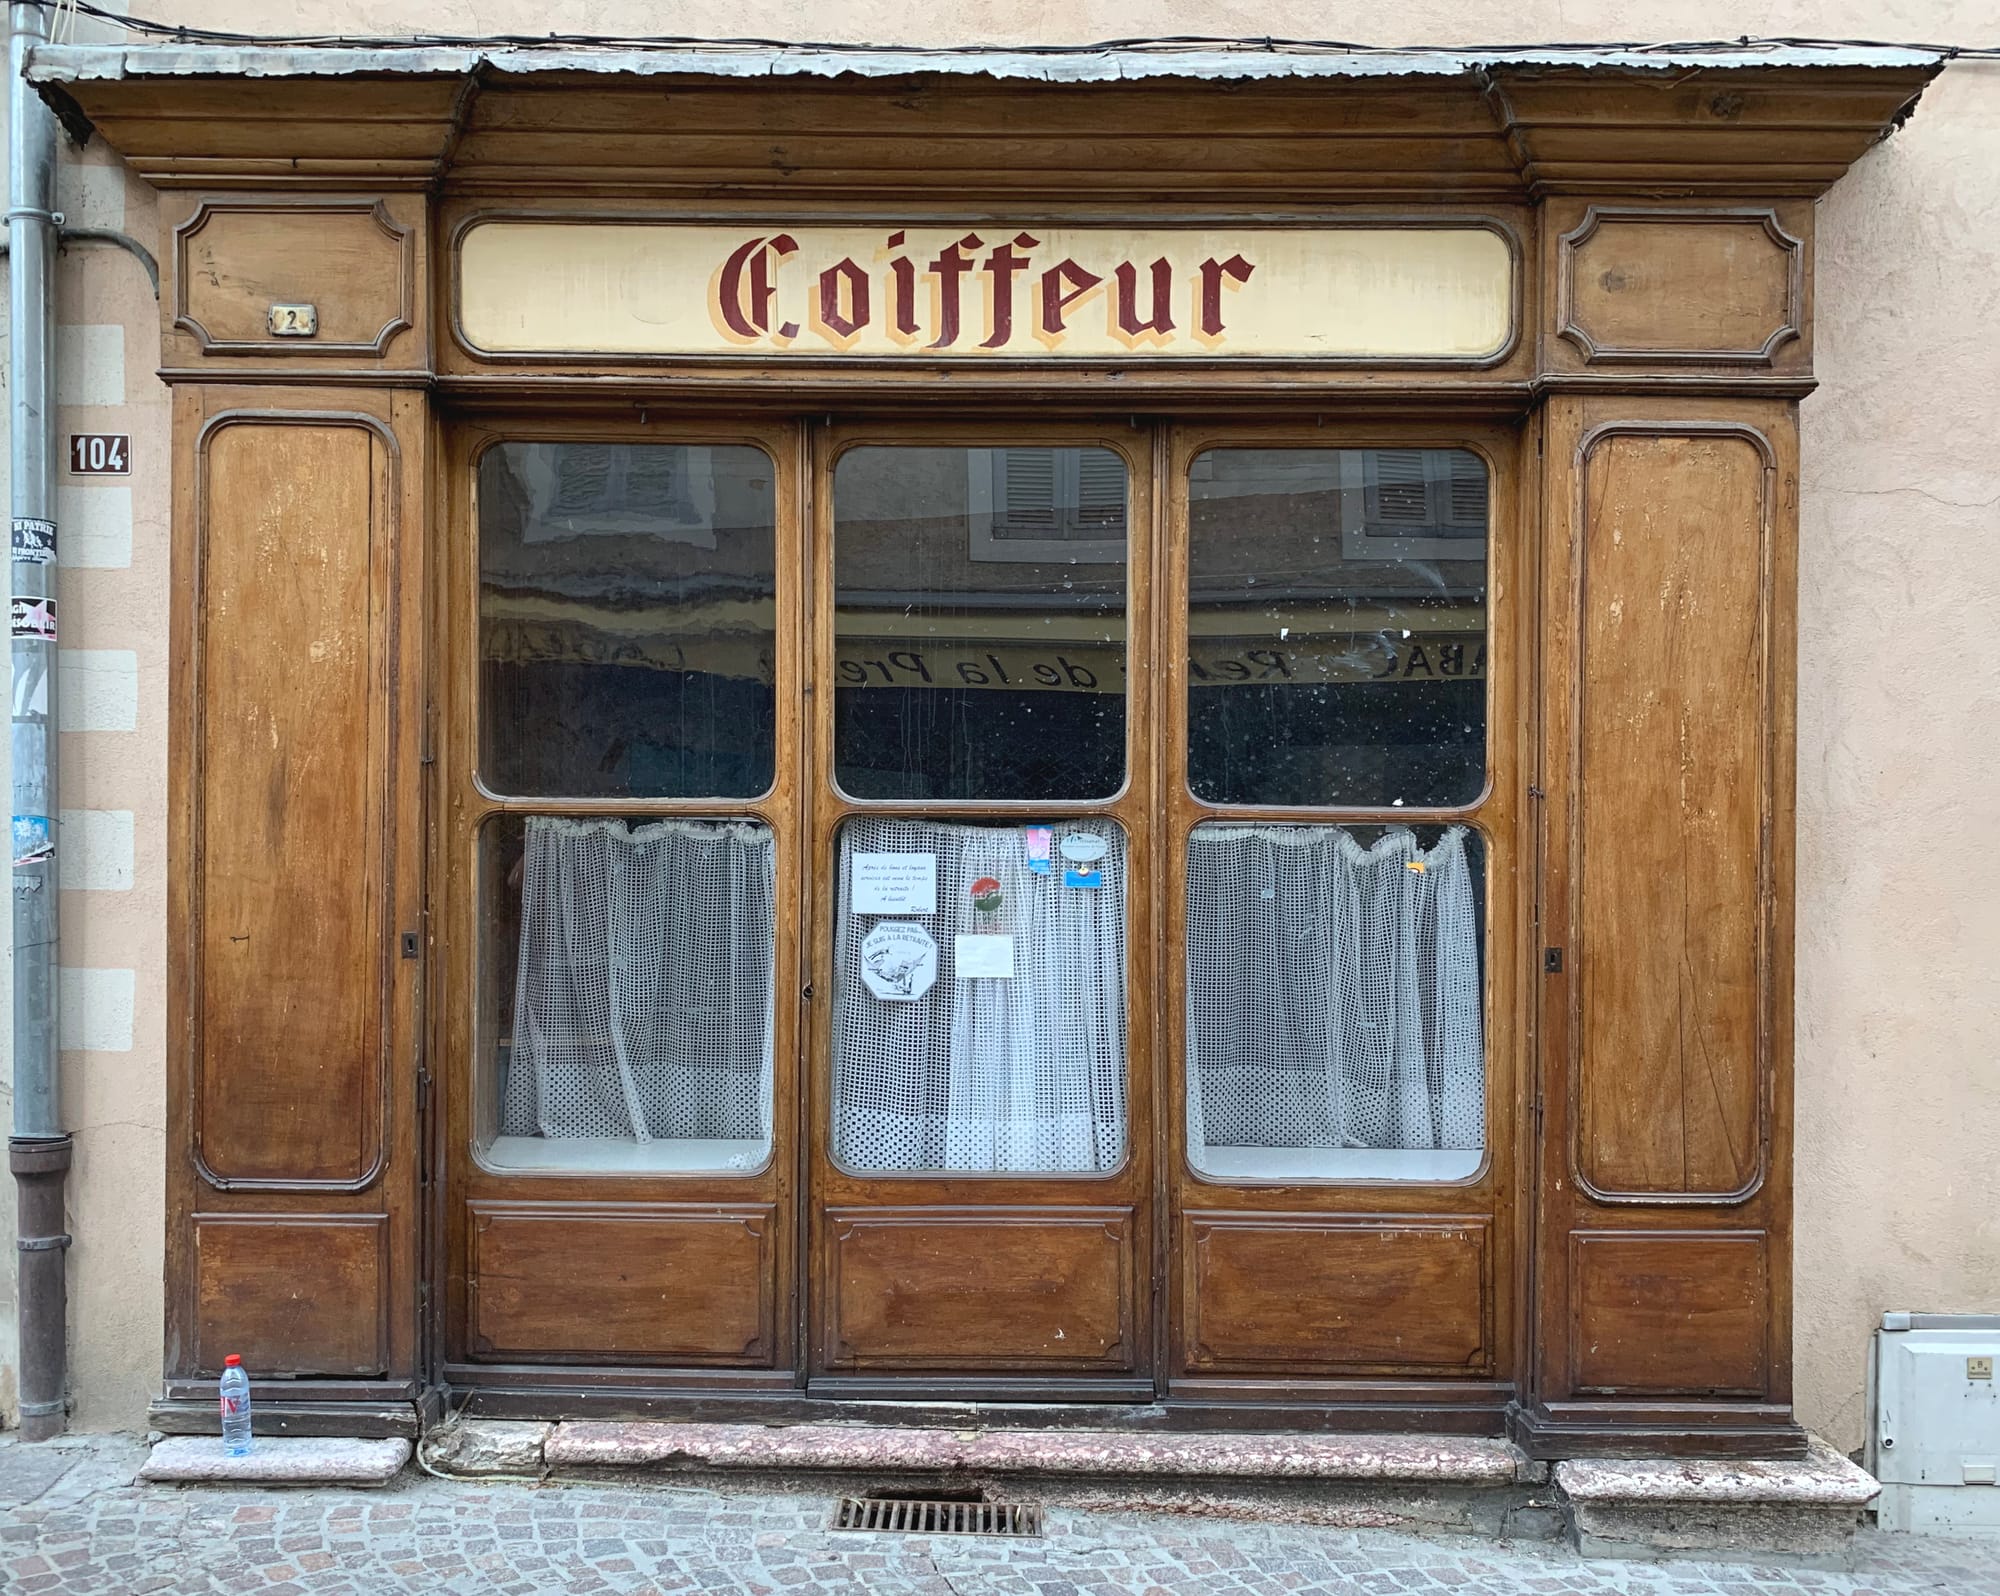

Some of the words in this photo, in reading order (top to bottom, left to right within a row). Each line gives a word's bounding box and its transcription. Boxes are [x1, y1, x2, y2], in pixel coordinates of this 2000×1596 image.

[708, 231, 1256, 350] Coiffeur
[287, 310, 297, 330] 2
[76, 437, 123, 470] 104
